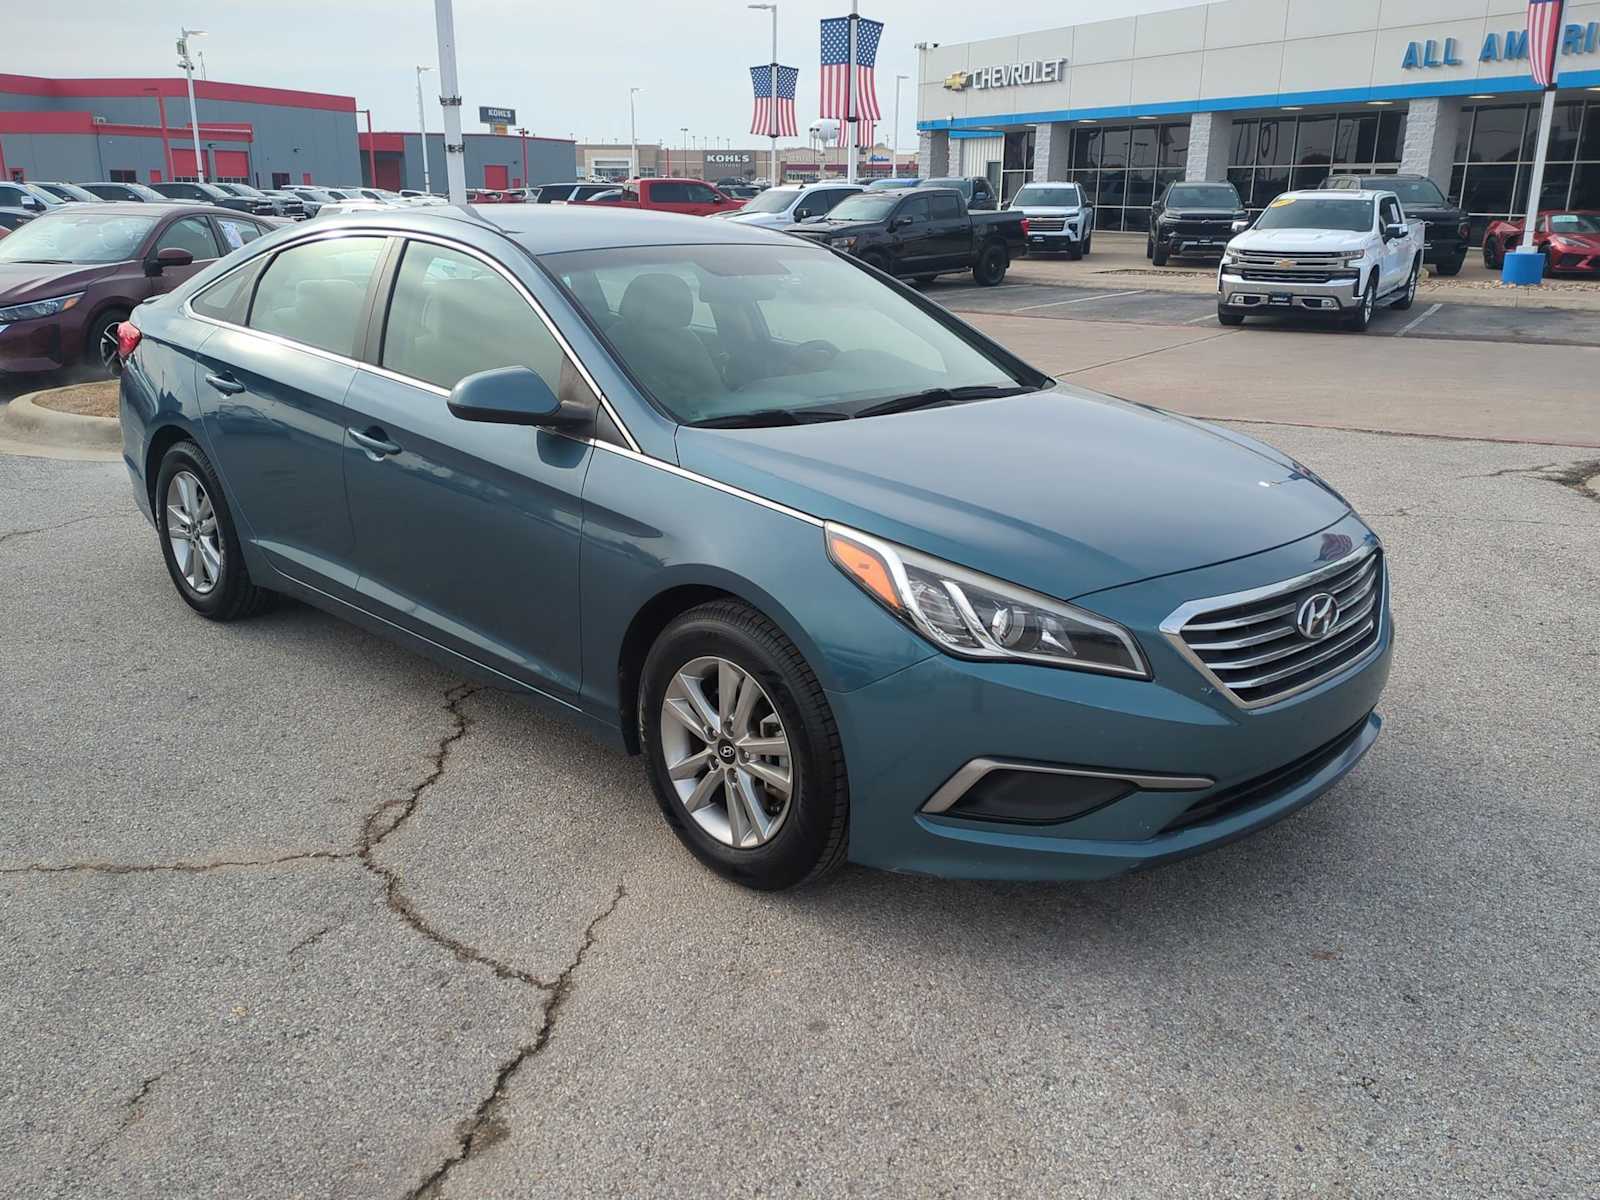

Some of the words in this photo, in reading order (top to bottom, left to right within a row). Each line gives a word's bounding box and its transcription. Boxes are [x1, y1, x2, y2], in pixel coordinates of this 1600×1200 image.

[1402, 37, 1462, 69] ALL
[1479, 22, 1600, 63] AMRI
[973, 57, 1067, 90] CHEVROLET
[706, 153, 750, 163] KOHL'S
